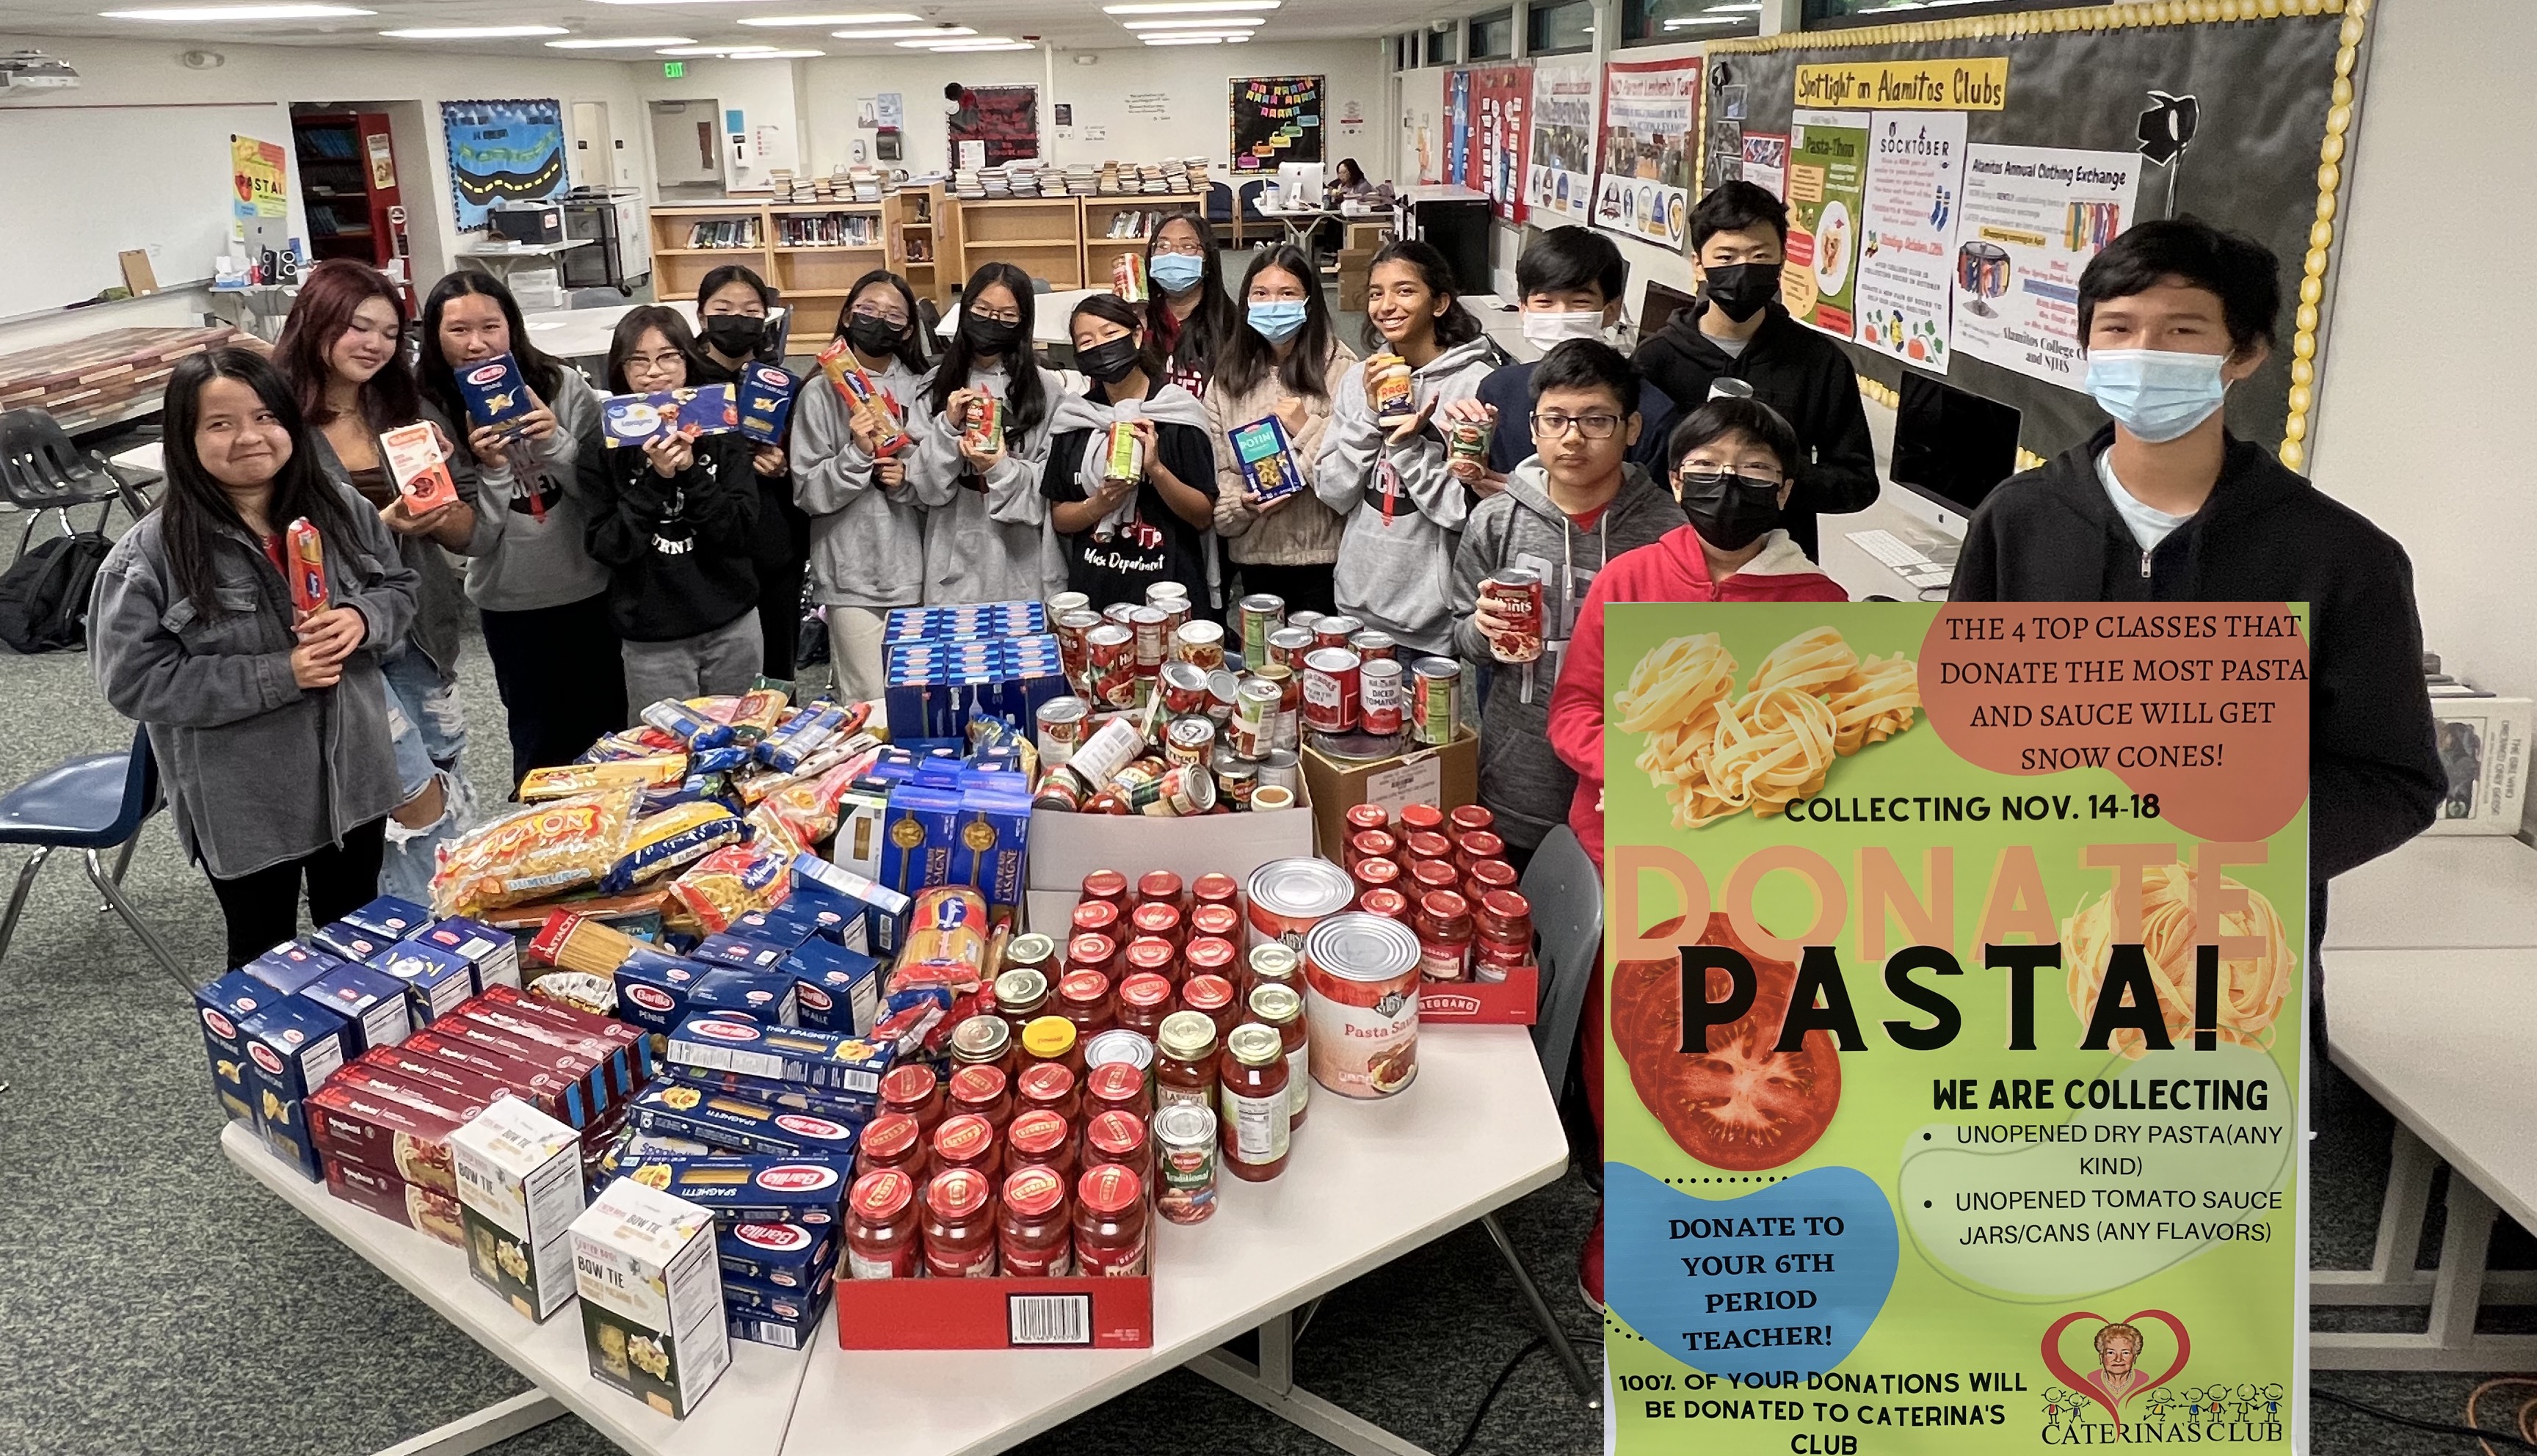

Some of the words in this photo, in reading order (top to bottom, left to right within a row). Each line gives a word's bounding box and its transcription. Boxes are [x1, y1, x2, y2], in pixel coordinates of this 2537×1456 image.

[1799, 69, 1854, 106] Spotlight
[1858, 81, 1870, 99] on
[1878, 69, 1944, 102] Alamitos
[1953, 68, 2002, 106] Clubs
[1880, 138, 1950, 156] SOCKTOBER
[1972, 159, 2003, 175] Alamitos
[2004, 161, 2036, 177] Annual
[2038, 163, 2074, 186] Clothing
[2075, 166, 2127, 191] Exchange
[2003, 327, 2039, 348] Alamitos
[2040, 338, 2075, 360] College
[2025, 352, 2043, 365] and
[1108, 552, 1165, 575] Department
[1946, 618, 2004, 640] THE
[2011, 622, 2026, 643] 4
[2033, 617, 2089, 640] TOP
[2095, 615, 2217, 638] CLASSES
[2224, 615, 2302, 638] THAT
[1940, 661, 2058, 684] DONATE
[2065, 660, 2124, 683] THE
[2132, 659, 2213, 682] MOST
[2221, 658, 2309, 681] PASTA
[1371, 689, 1394, 698] DICED
[1970, 705, 2033, 727] AND
[2040, 702, 2133, 727] SAUCE
[2140, 702, 2213, 724] WILL
[2219, 702, 2276, 724] GET
[2021, 746, 2110, 770] SNOW
[2116, 743, 2224, 768] CONES!
[1784, 796, 1991, 823] COLLECTING
[2001, 795, 2080, 822] NOV.
[2088, 793, 2161, 821] 14-18
[678, 848, 702, 862] ELBOW
[1002, 849, 1018, 902] LASAGNE
[1608, 841, 2270, 964] DONATE
[636, 989, 671, 1008] Barilla
[1676, 942, 2221, 1054] PASTA!
[705, 1023, 755, 1038] Barilla
[766, 1024, 787, 1033] THIN
[788, 1029, 839, 1042] SPAGHETTI
[1345, 1023, 1390, 1039] Pasta
[1933, 1079, 1978, 1110] WE
[1988, 1079, 2055, 1110] ARE
[2064, 1079, 2269, 1110] COLLECTING
[706, 1110, 757, 1126] SPAGHETTI
[783, 1116, 835, 1135] Barilla
[1956, 1124, 2088, 1144] UNOPENED
[2094, 1124, 2141, 1144] DRY
[2147, 1124, 2283, 1147] PASTA(ANY
[1166, 1171, 1209, 1182] Traditional
[2079, 1156, 2144, 1177] KIND)
[457, 1162, 478, 1185] BOW
[479, 1174, 495, 1196] TIE
[763, 1172, 821, 1185] Barilla
[681, 1187, 738, 1197] SPAGHETTI
[1956, 1190, 2086, 1212] UNOPENED
[2091, 1190, 2196, 1209] TOMATO
[2202, 1190, 2283, 1209] SAUCE
[626, 1214, 650, 1228] BOW
[647, 1222, 663, 1234] TIE
[741, 1224, 795, 1245] Barilla
[1669, 1217, 1796, 1240] DONATE
[1804, 1216, 1845, 1237] TO
[1959, 1223, 2090, 1245] JARS/CANS
[2097, 1222, 2152, 1244] (ANY
[2156, 1221, 2272, 1244] FLAVORS)
[578, 1255, 603, 1280] BOW
[606, 1267, 625, 1289] TIE
[1681, 1254, 1768, 1277] YOUR
[1775, 1253, 1835, 1274] 6TH
[1705, 1289, 1818, 1314] PERIOD
[1683, 1325, 1832, 1351] TEACHER!
[1619, 1374, 1676, 1392] 100%
[1684, 1373, 1719, 1391] OF
[1727, 1371, 1799, 1390] YOUR
[1807, 1371, 1960, 1395] DONATIONS
[1969, 1372, 2028, 1392] WILL
[1645, 1400, 1675, 1419] BE
[1684, 1400, 1804, 1422] DONATED
[1813, 1402, 1848, 1423] TO
[1857, 1403, 2006, 1427] CATERINA'S
[1790, 1434, 1858, 1456] CLUB
[2041, 1422, 2202, 1445] CATERINA'S
[2206, 1422, 2282, 1443] CLUB
